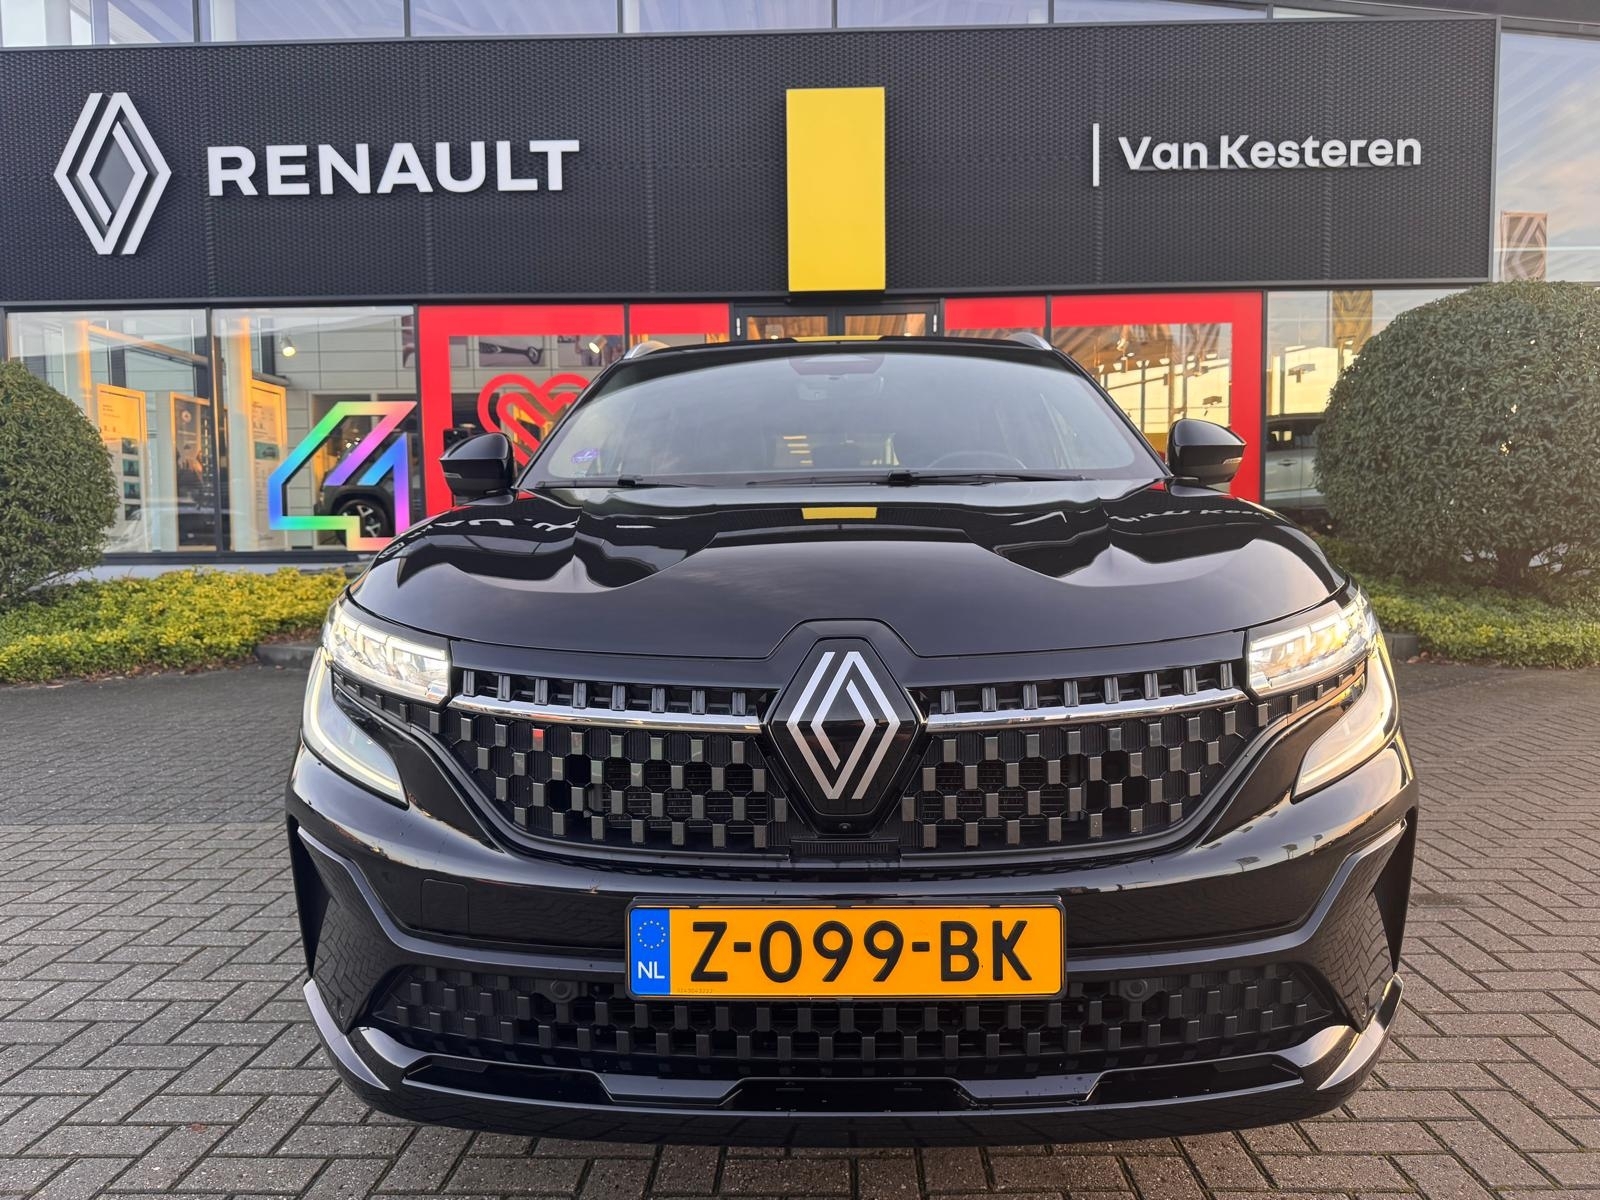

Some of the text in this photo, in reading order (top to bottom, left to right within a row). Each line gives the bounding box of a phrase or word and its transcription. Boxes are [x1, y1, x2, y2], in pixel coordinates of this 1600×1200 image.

[207, 139, 580, 197] RENAULT
[1118, 133, 1422, 171] Van Kesteren
[637, 960, 665, 980] NL
[690, 920, 1033, 983] Z-099-BK
